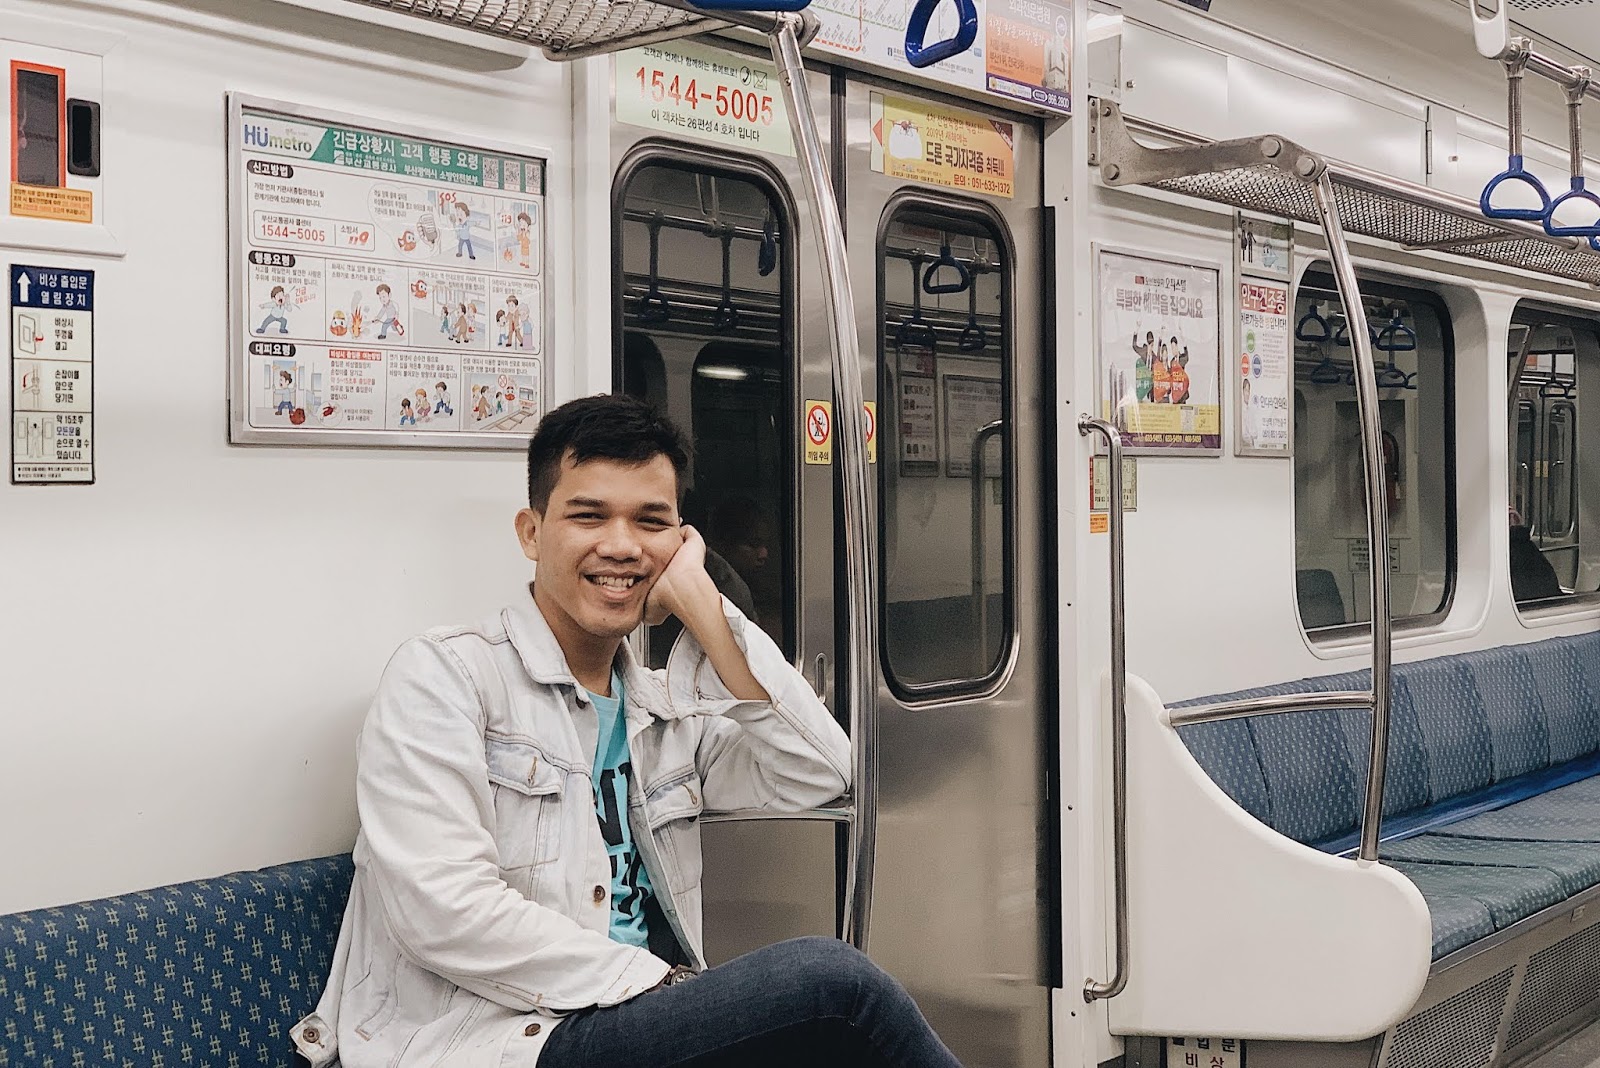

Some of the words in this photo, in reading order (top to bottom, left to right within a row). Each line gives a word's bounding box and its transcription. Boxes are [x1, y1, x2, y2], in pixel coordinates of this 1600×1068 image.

[643, 47, 662, 59] 고객과
[664, 51, 683, 64] 언제나
[686, 57, 710, 71] 함께하는
[712, 63, 738, 78] 휴메트로!
[636, 66, 773, 126] 1544-5005
[651, 109, 660, 122] 이
[662, 111, 686, 127] 객차는
[738, 127, 760, 142] 입니다
[333, 131, 394, 156] 긴급상황시
[400, 143, 423, 162] 고객
[428, 147, 451, 166] 행동
[457, 152, 478, 170] 요령
[926, 142, 942, 166] 드론
[945, 144, 984, 174] 국가자격증
[253, 162, 288, 177] 신고방법
[346, 157, 396, 173] 부산교통공사
[954, 174, 966, 186] 문의
[972, 178, 1010, 194] 051-633-1372
[440, 192, 456, 208] SOS
[262, 215, 294, 225] 부산교통공사
[262, 224, 325, 242] 1544-5005
[341, 225, 358, 234] 소방서
[40, 273, 57, 288] 비상
[61, 275, 87, 289] 출입문
[1165, 277, 1186, 292] 오피스텔
[295, 287, 306, 297] 긴급
[1242, 284, 1286, 313] 안구건조증
[1116, 288, 1141, 312] 특별한
[1143, 288, 1168, 315] 혜택을
[55, 318, 73, 327] 비상시
[55, 329, 73, 340] 뚜껑을
[55, 342, 67, 350] 열고
[255, 344, 291, 356] 대피요령
[55, 370, 79, 380] 손잡이를
[55, 381, 73, 391] 앞으로
[55, 393, 74, 403] 당기면
[56, 414, 62, 424] 약
[56, 426, 81, 436] 모든문을
[56, 439, 74, 448] 손으로
[84, 439, 89, 448] 수
[819, 451, 829, 461] 주의
